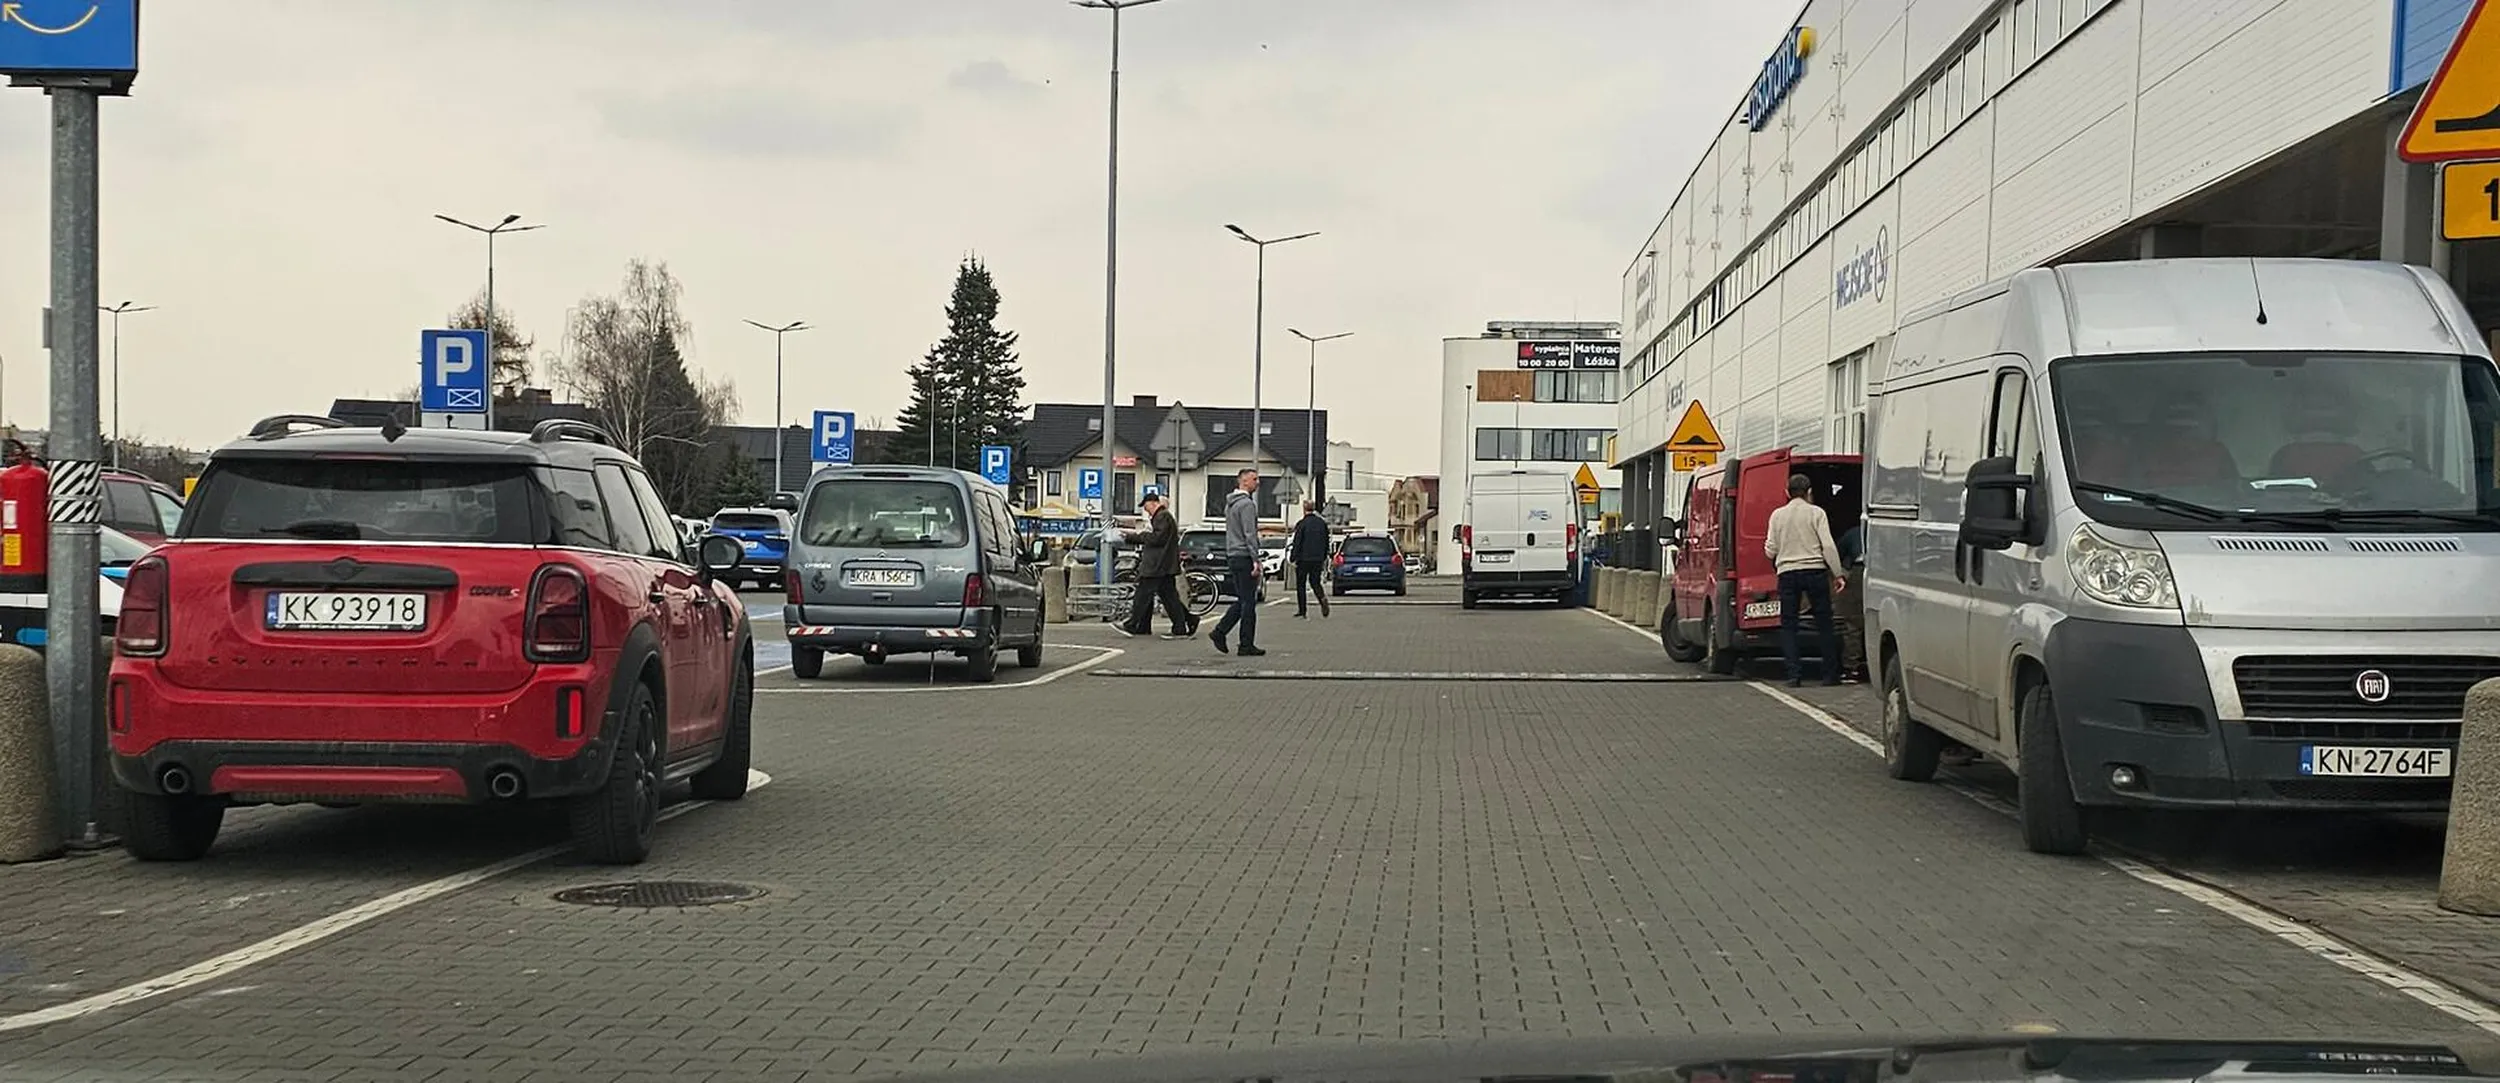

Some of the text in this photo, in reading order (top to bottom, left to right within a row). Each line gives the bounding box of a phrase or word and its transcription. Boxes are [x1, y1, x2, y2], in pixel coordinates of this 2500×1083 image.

[1836, 245, 1874, 310] WEJŚCIE
[436, 337, 472, 386] P
[1585, 356, 1616, 366] Łóżka
[821, 415, 845, 447] P
[988, 450, 1004, 473] P
[1684, 456, 1697, 467] 15
[1084, 471, 1098, 490] P
[856, 570, 875, 582] KRA
[285, 597, 416, 622] KK 93918
[2364, 679, 2383, 695] FIAT
[2319, 749, 2443, 774] KN 2764F
